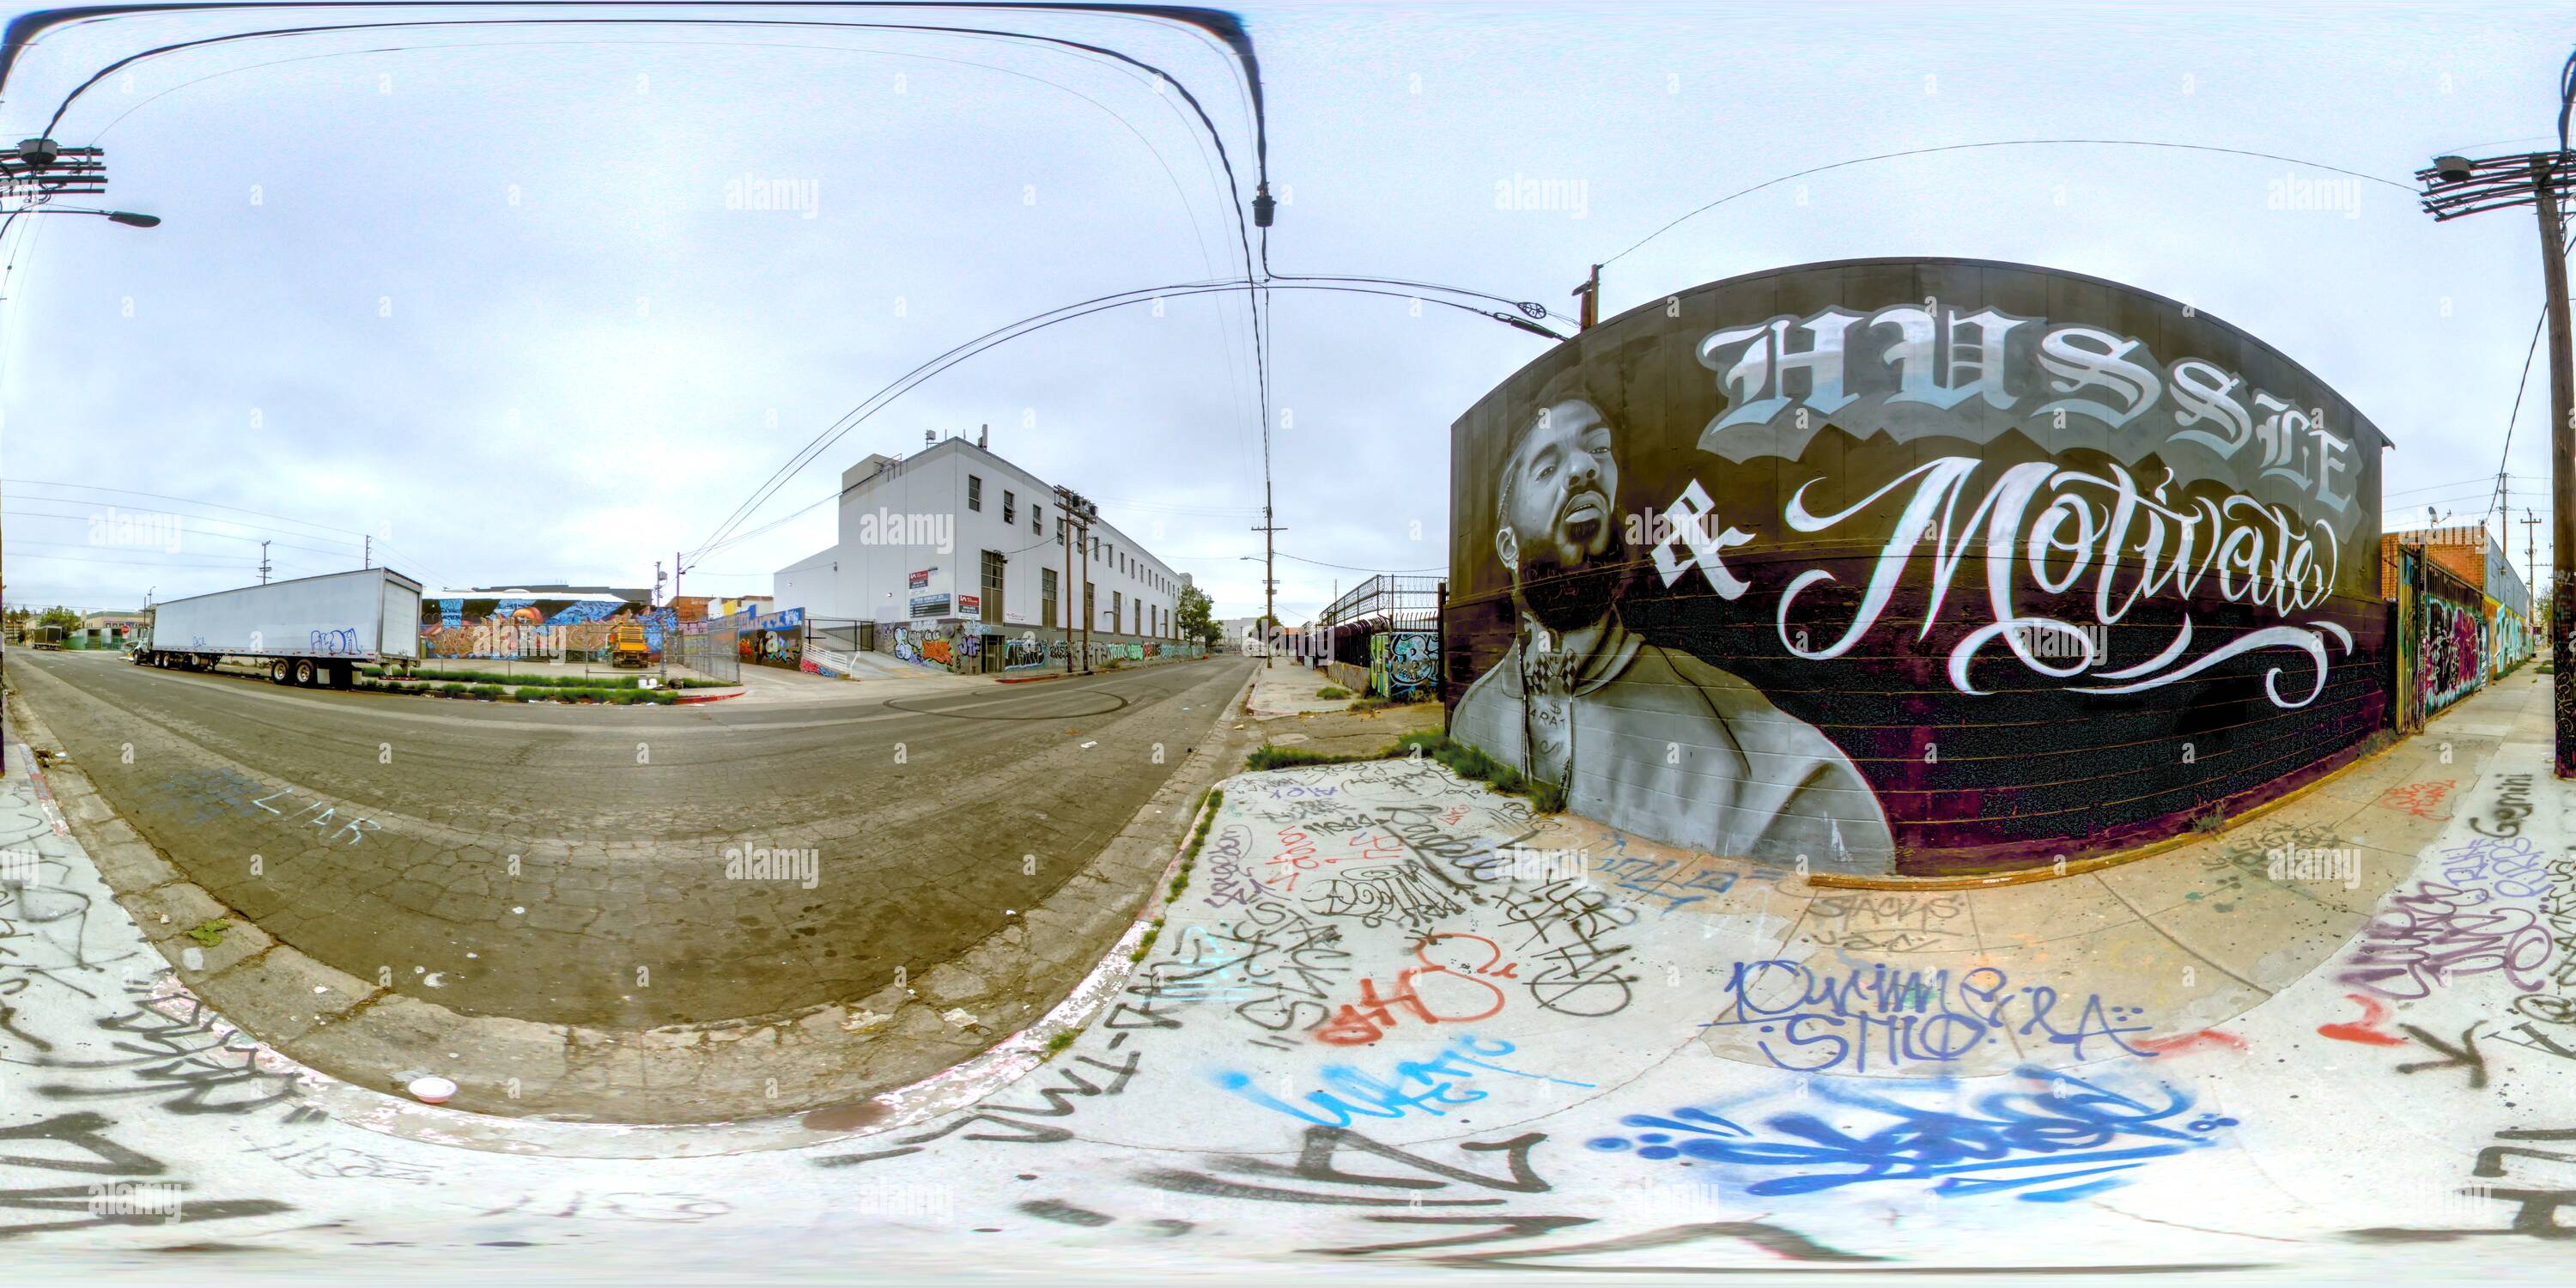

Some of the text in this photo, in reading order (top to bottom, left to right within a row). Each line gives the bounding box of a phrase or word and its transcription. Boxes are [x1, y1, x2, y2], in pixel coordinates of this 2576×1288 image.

[1702, 304, 2358, 513] HUSSLE
[1777, 455, 2354, 709] Motivate
[252, 787, 381, 845] LIAR
[2470, 773, 2534, 838] Gemini
